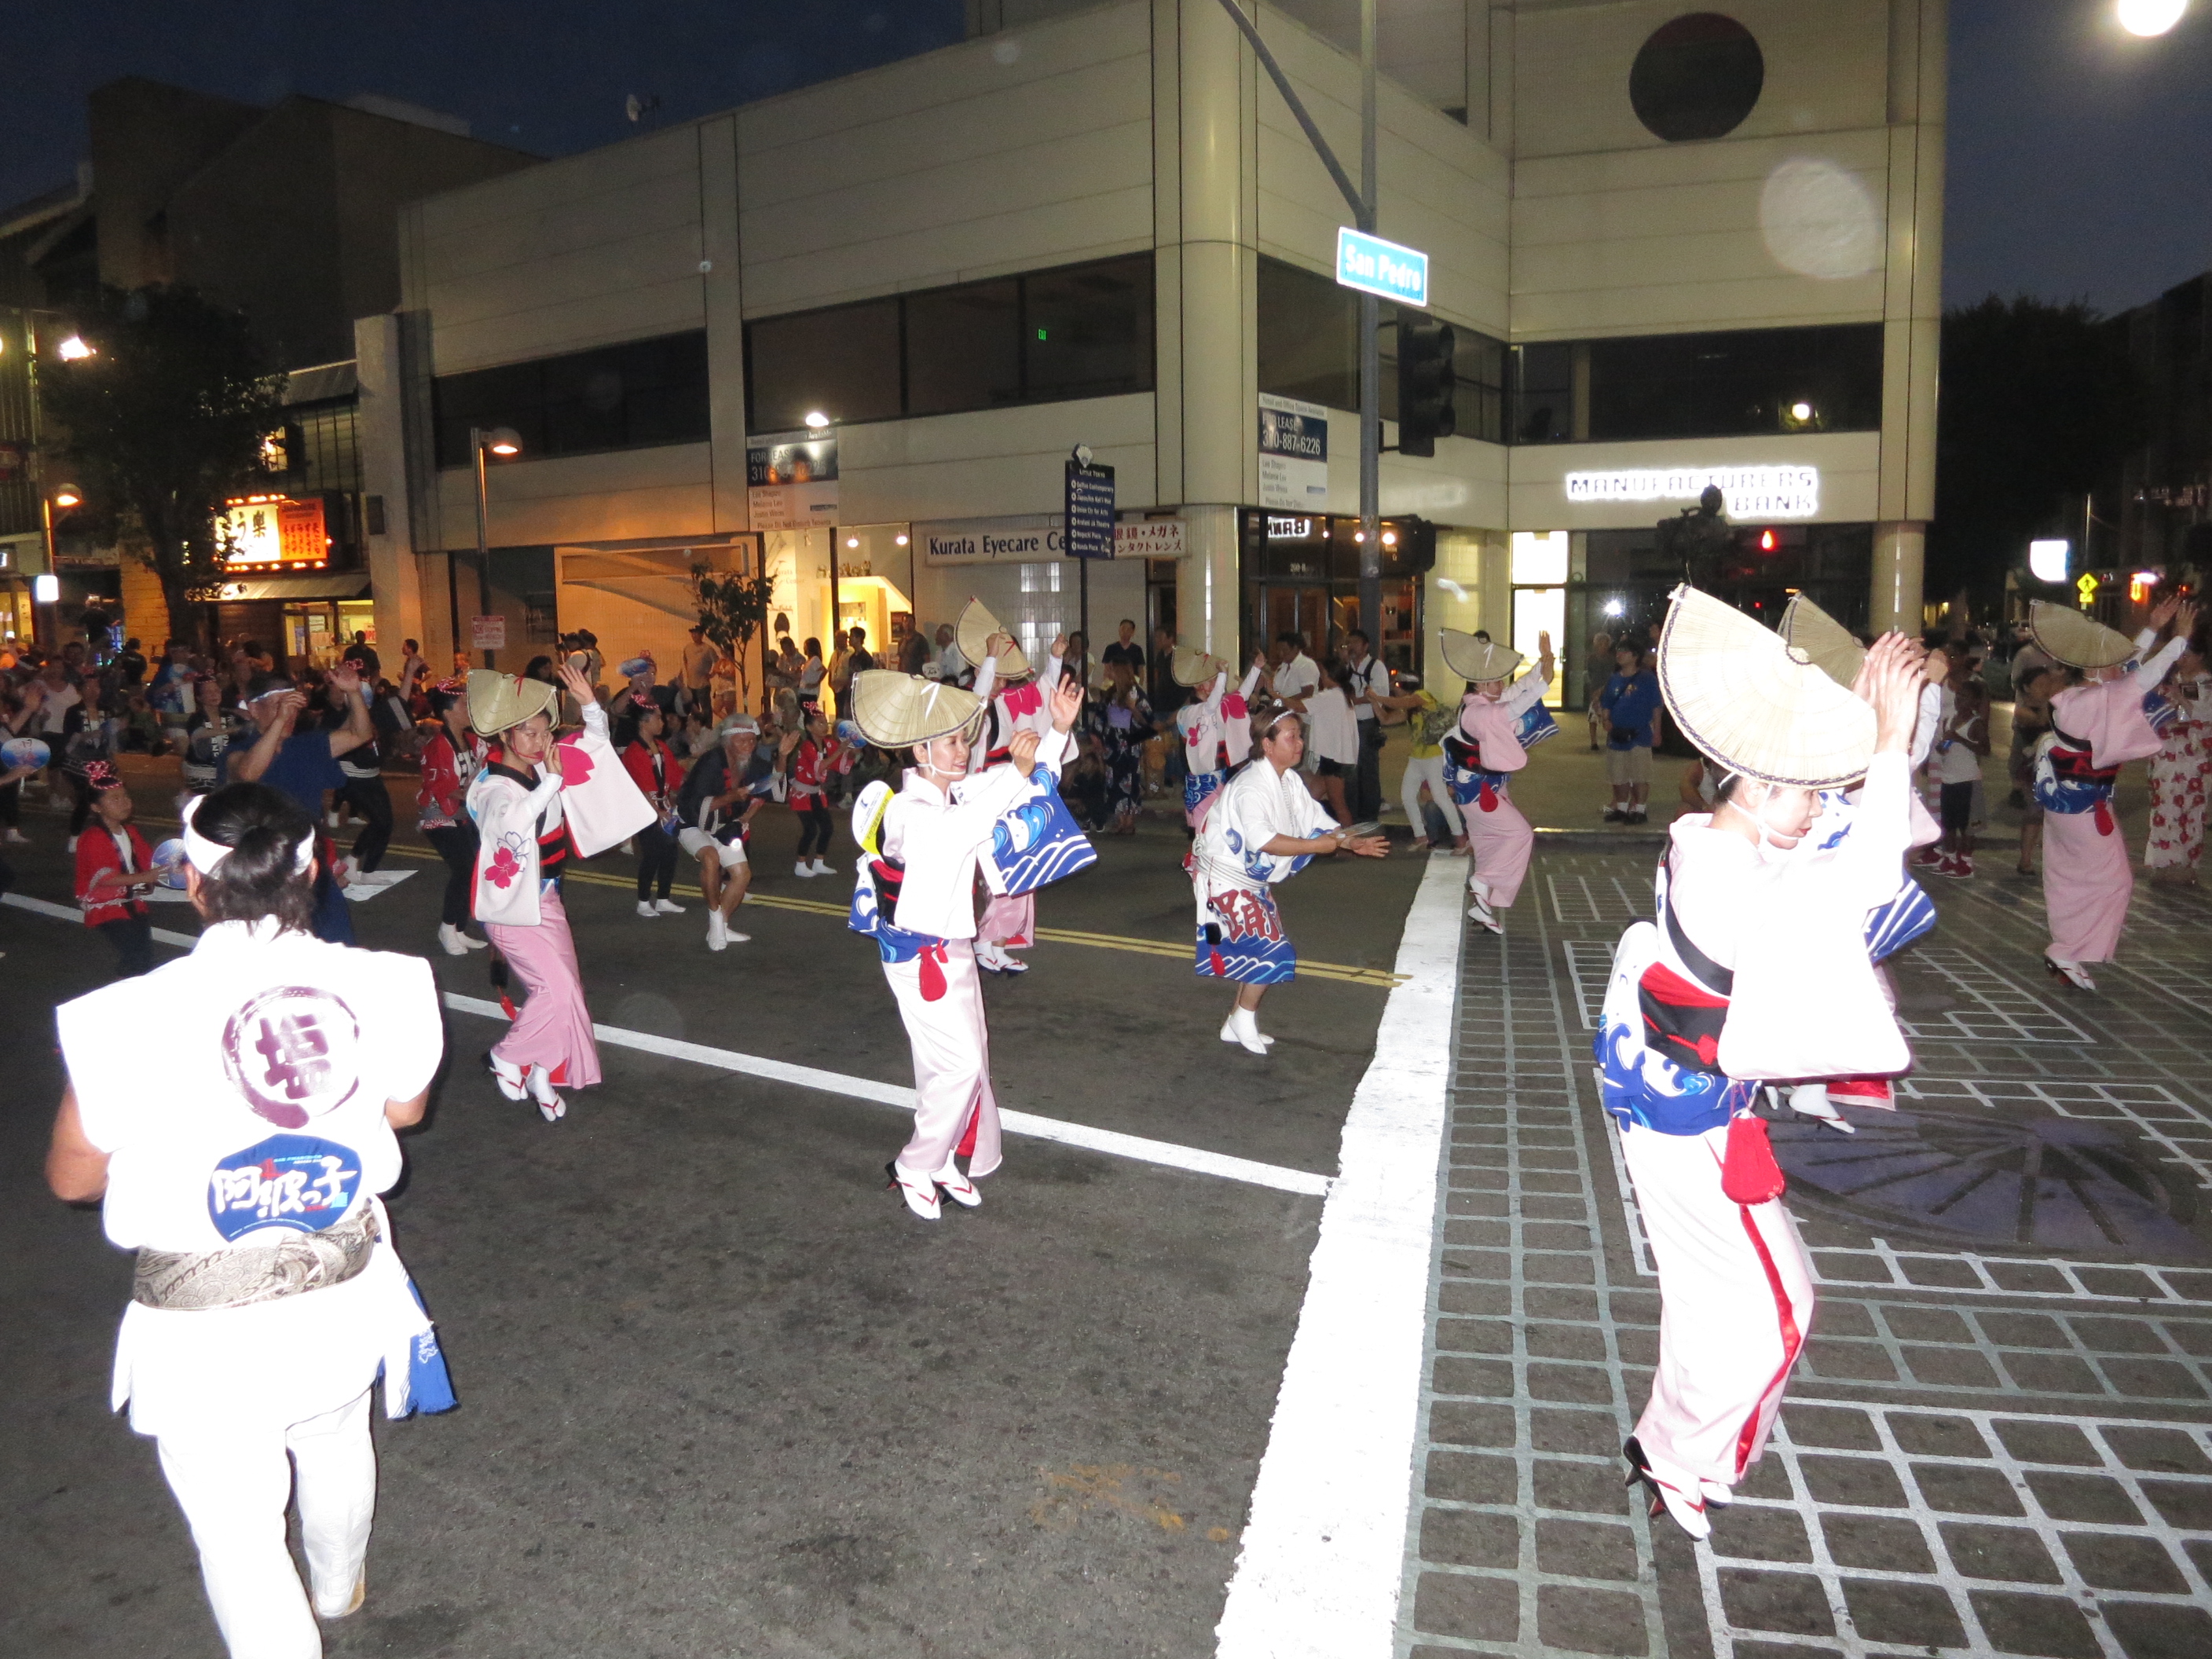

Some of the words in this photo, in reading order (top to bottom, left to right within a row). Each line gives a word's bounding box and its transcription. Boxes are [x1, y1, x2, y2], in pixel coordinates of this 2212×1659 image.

[1346, 244, 1375, 278] San
[1378, 254, 1421, 291] Pedro
[1277, 416, 1298, 431] LEASE
[1262, 430, 1321, 456] 310-887-6226
[751, 452, 767, 463] FOR
[1571, 472, 1811, 493] MANUFACTURERS
[1734, 495, 1811, 511] BANK
[929, 537, 976, 556] Kurata
[983, 535, 1039, 558] Eyecare
[255, 1013, 332, 1100] 塩
